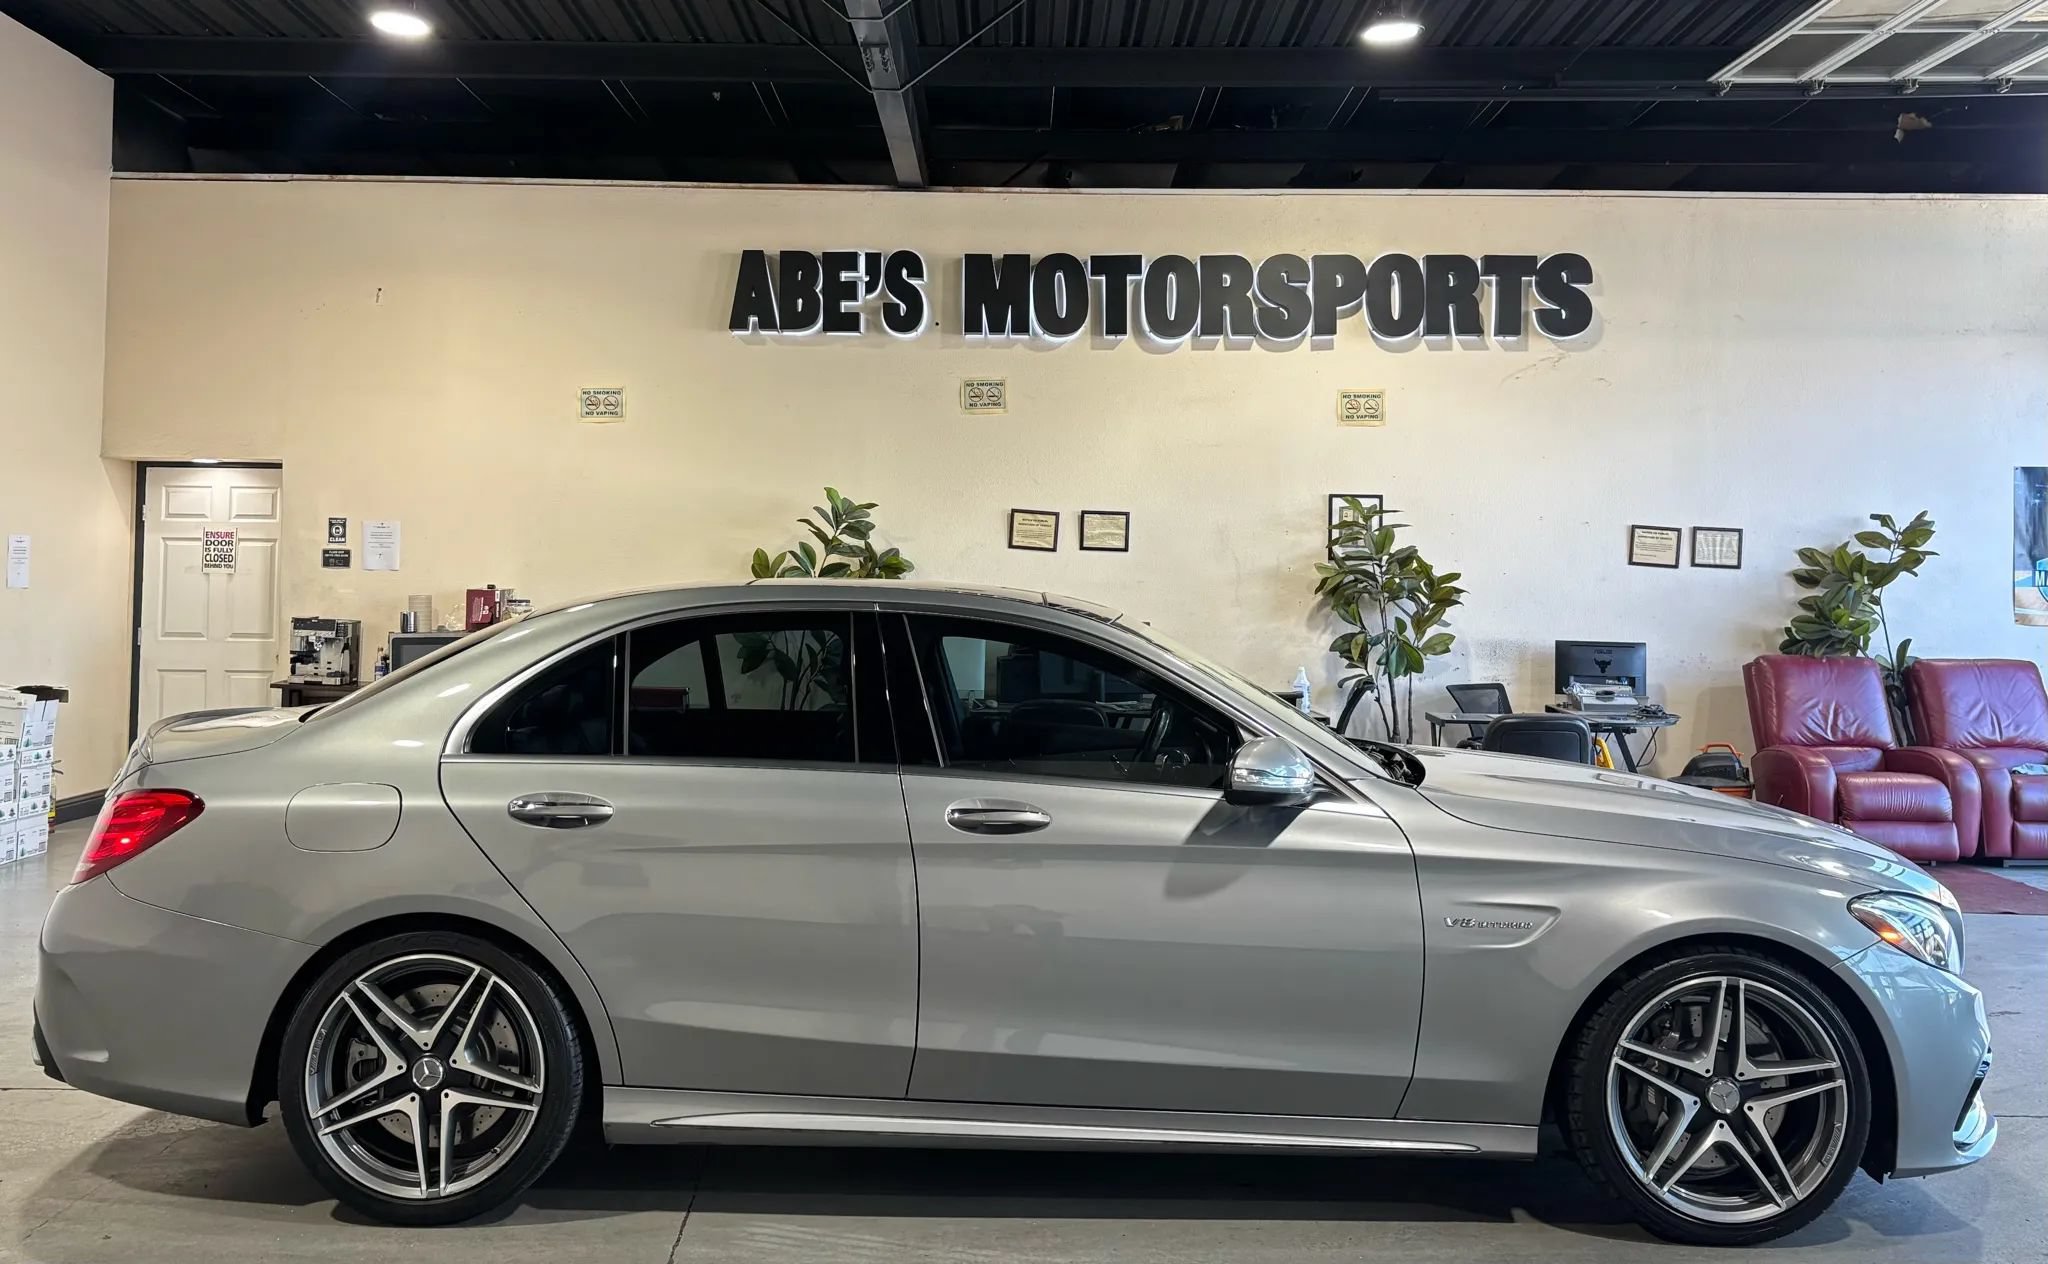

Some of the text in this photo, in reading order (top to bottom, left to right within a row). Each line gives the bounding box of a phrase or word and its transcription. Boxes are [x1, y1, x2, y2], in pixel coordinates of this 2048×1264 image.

[729, 250, 1594, 338] ABE'S MOTORSPORTS
[205, 531, 235, 539] ENSURE
[205, 539, 234, 547] DOOR
[204, 553, 234, 563] CLOSED
[2035, 570, 2048, 587] M
